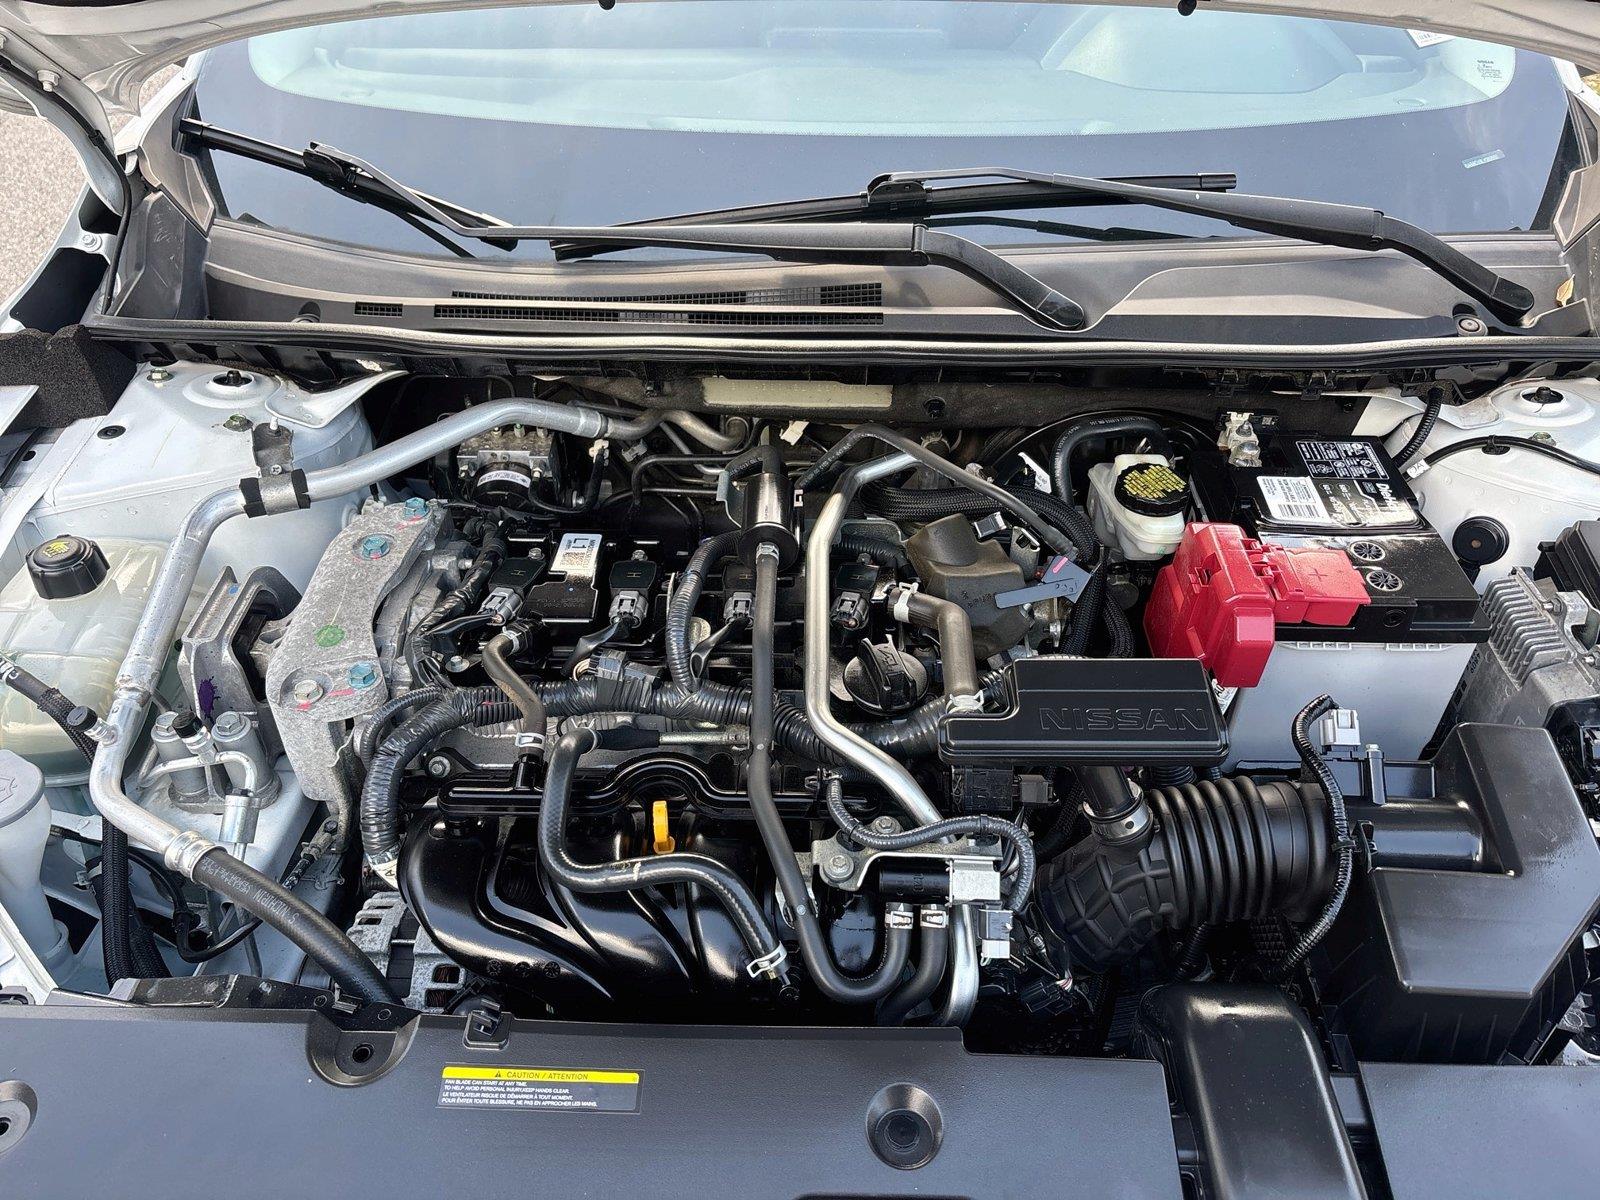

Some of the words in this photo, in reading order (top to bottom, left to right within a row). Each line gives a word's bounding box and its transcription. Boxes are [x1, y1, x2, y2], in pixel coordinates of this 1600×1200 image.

[1039, 708, 1208, 731] NISSAN
[507, 1071, 540, 1079] CAUTION
[548, 1073, 589, 1081] ATTENTION
